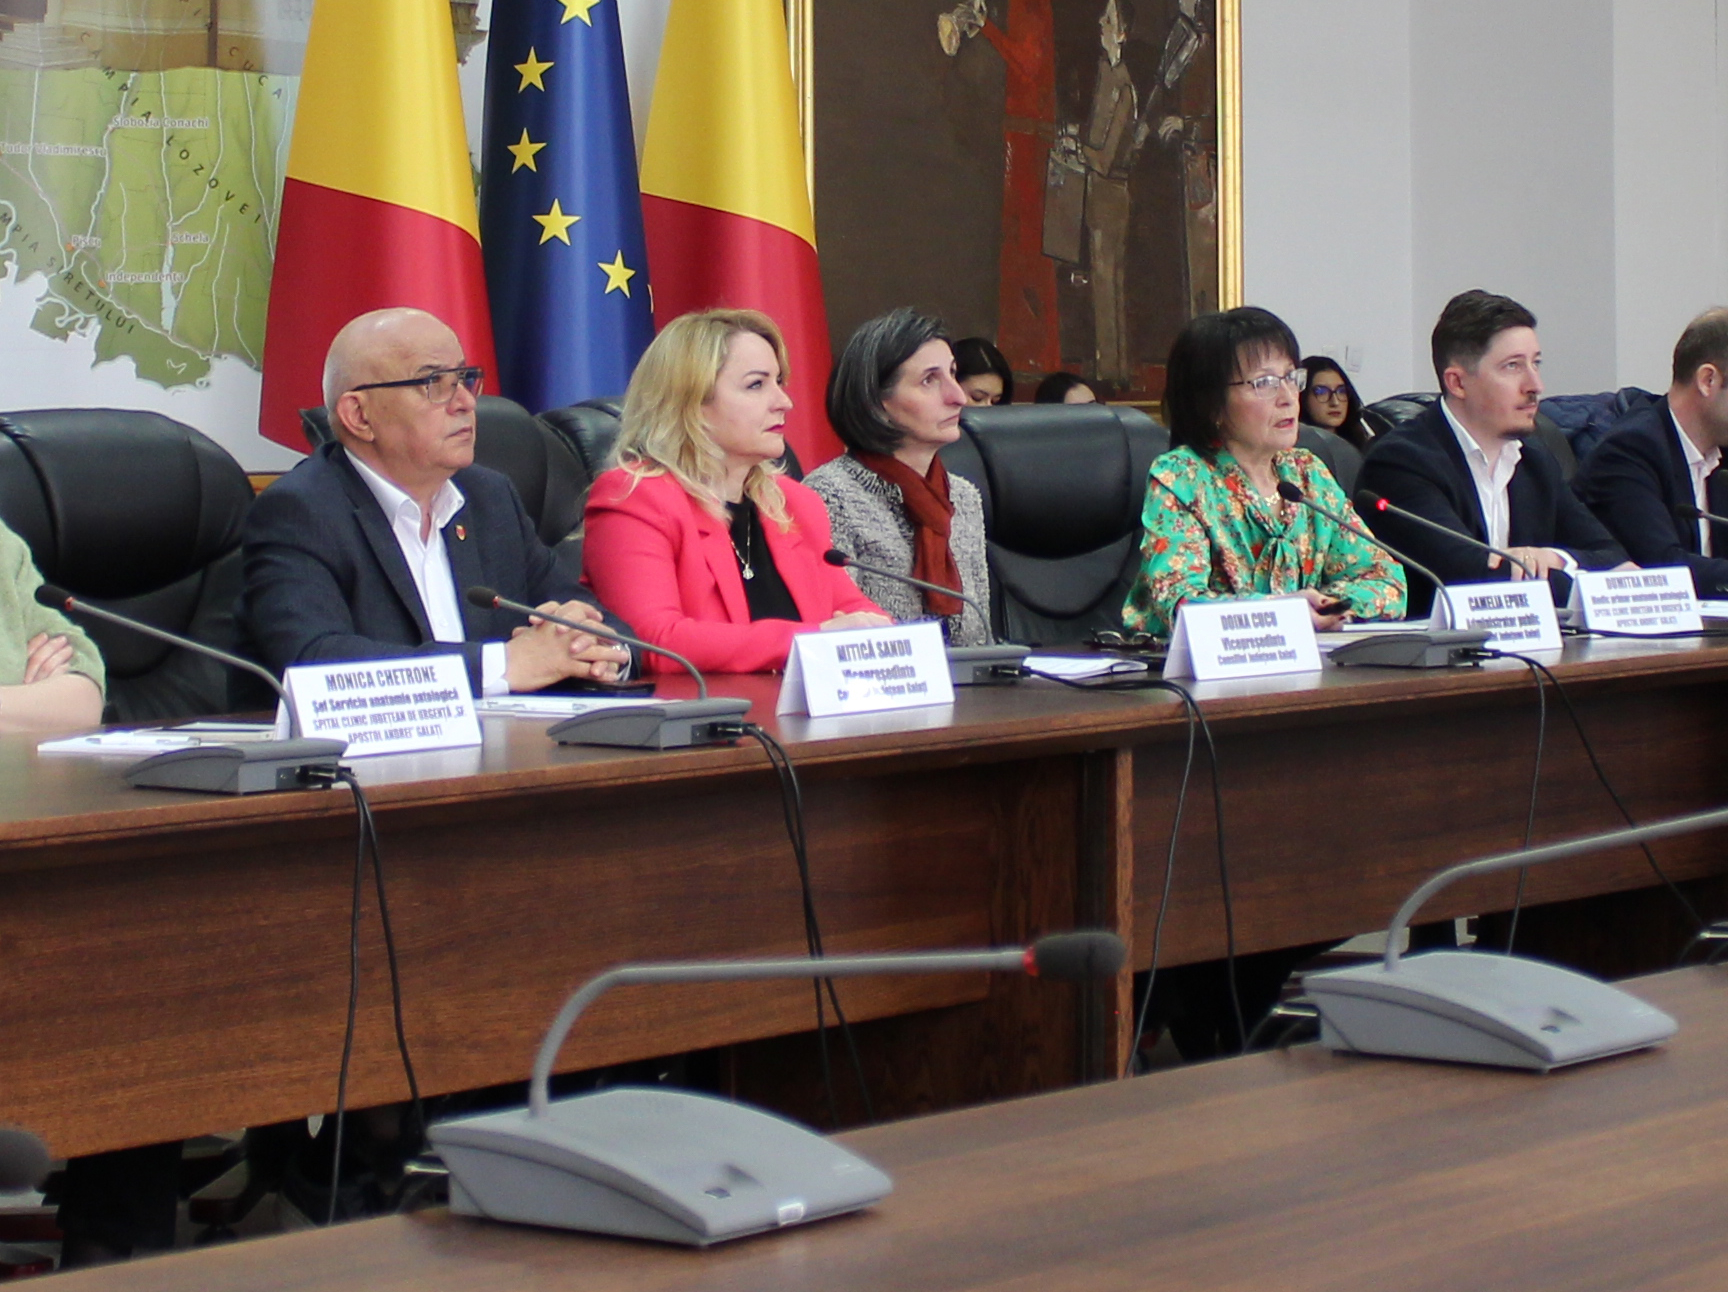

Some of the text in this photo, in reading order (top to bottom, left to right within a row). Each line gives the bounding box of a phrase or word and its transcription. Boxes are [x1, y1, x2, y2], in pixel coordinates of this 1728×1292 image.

[166, 135, 261, 223] LOZOVEI
[46, 256, 136, 335] SIRETULUI
[1468, 595, 1504, 611] CAMELIA
[1220, 611, 1278, 630] DOINA CUCU
[876, 639, 913, 659] SANDU
[325, 665, 438, 692] MONICA CHETRONE
[313, 718, 341, 731] SPITAL
[342, 715, 368, 728] CLINIC
[408, 710, 417, 721] DE
[348, 730, 383, 744] APOSTOL
